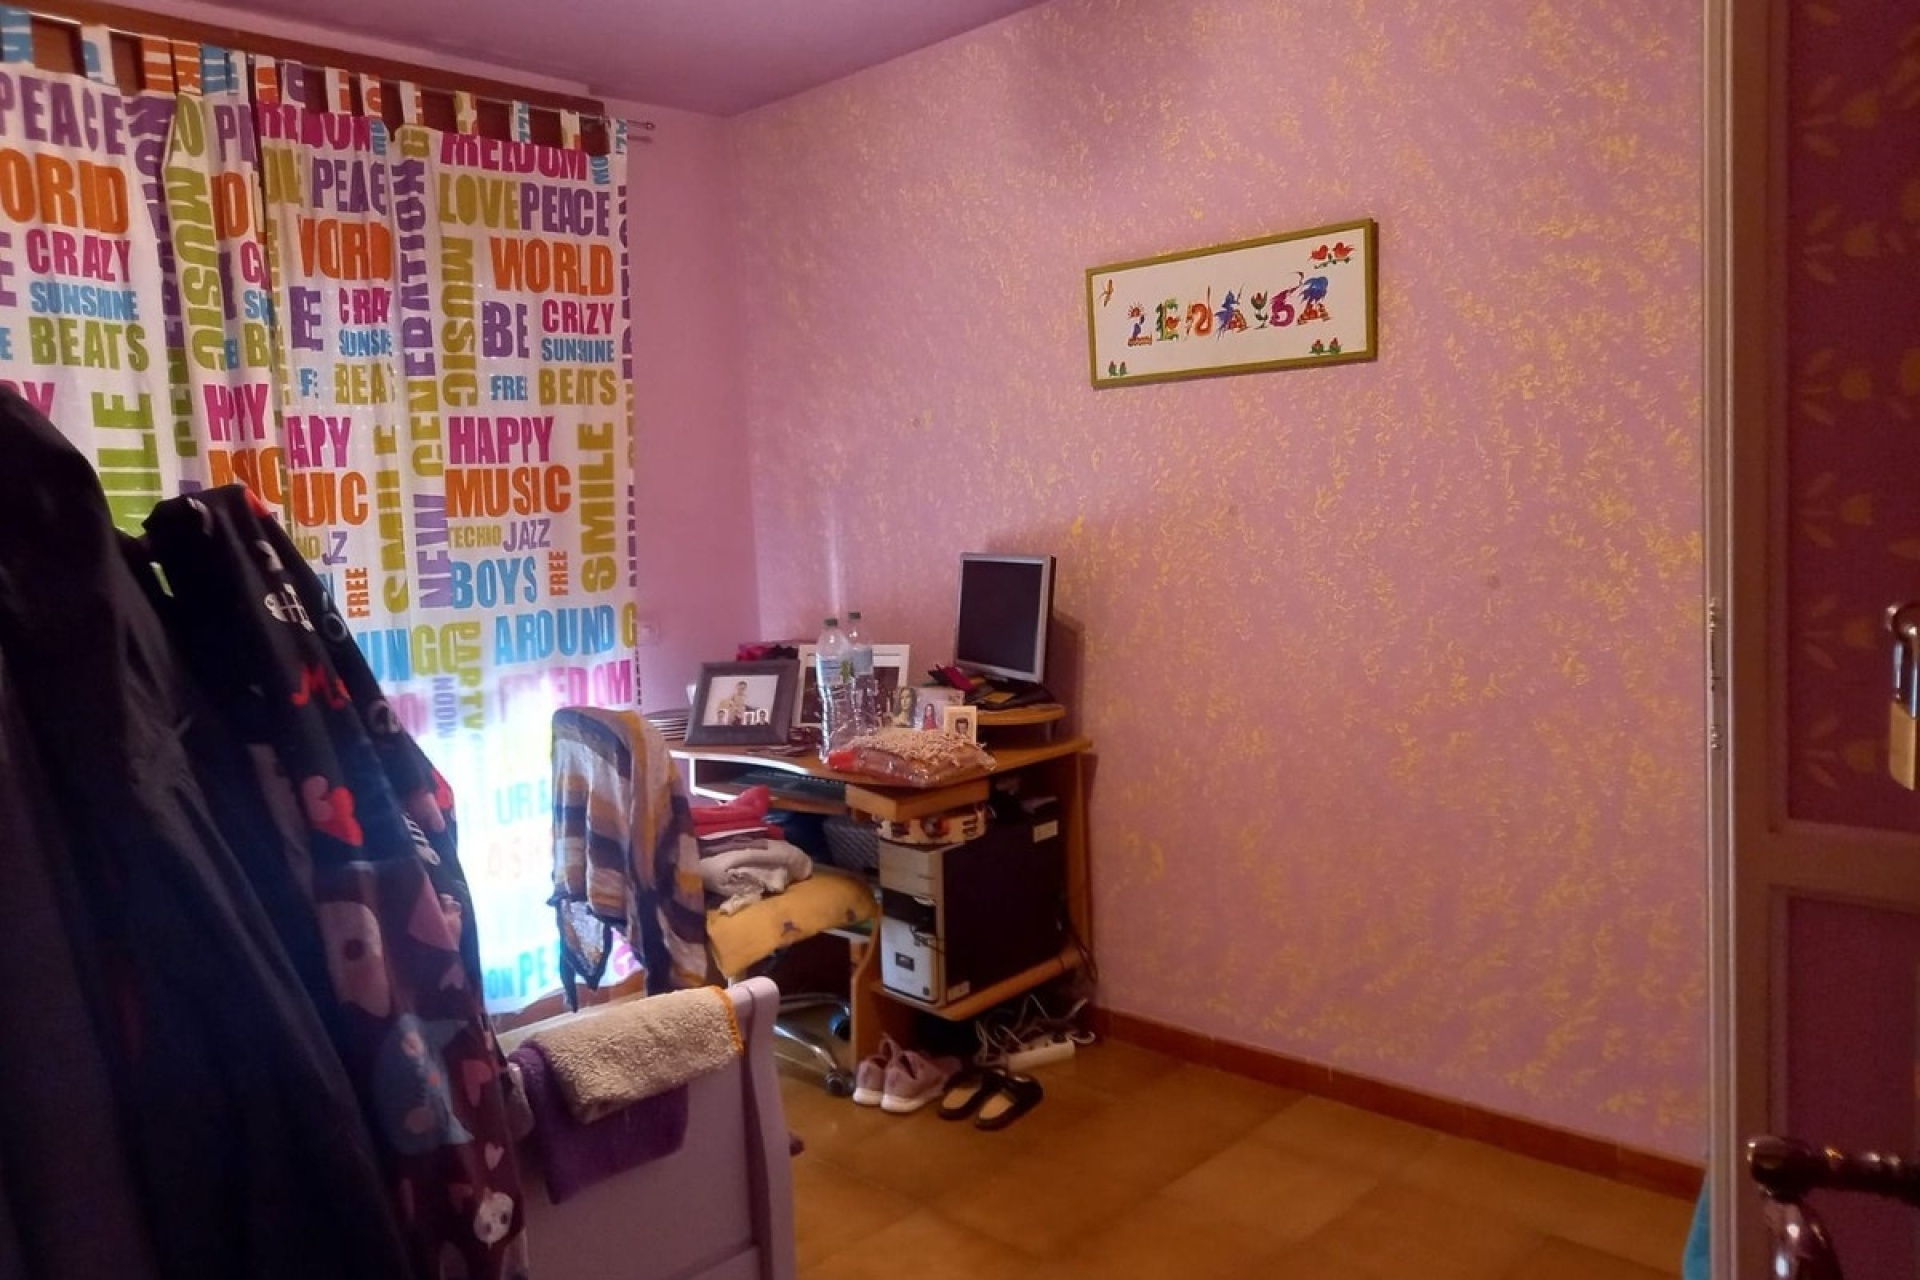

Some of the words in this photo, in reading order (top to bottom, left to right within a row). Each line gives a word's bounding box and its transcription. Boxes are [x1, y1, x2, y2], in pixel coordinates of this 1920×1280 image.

[438, 172, 520, 231] LOVE
[519, 181, 611, 236] PEACE
[26, 228, 131, 283] CRAZY
[489, 236, 614, 296] WORLD
[28, 316, 150, 372] BEATS
[440, 236, 478, 407] MUSIC
[448, 415, 554, 465] HAPPY
[444, 464, 572, 519] MUSIC
[576, 421, 618, 594] SMILE
[413, 493, 453, 609] NEW
[503, 518, 551, 552] JAZZ
[345, 567, 371, 619] FREE
[451, 555, 538, 610] BOYS
[548, 551, 569, 596] FREE
[495, 603, 615, 667] AROUND
